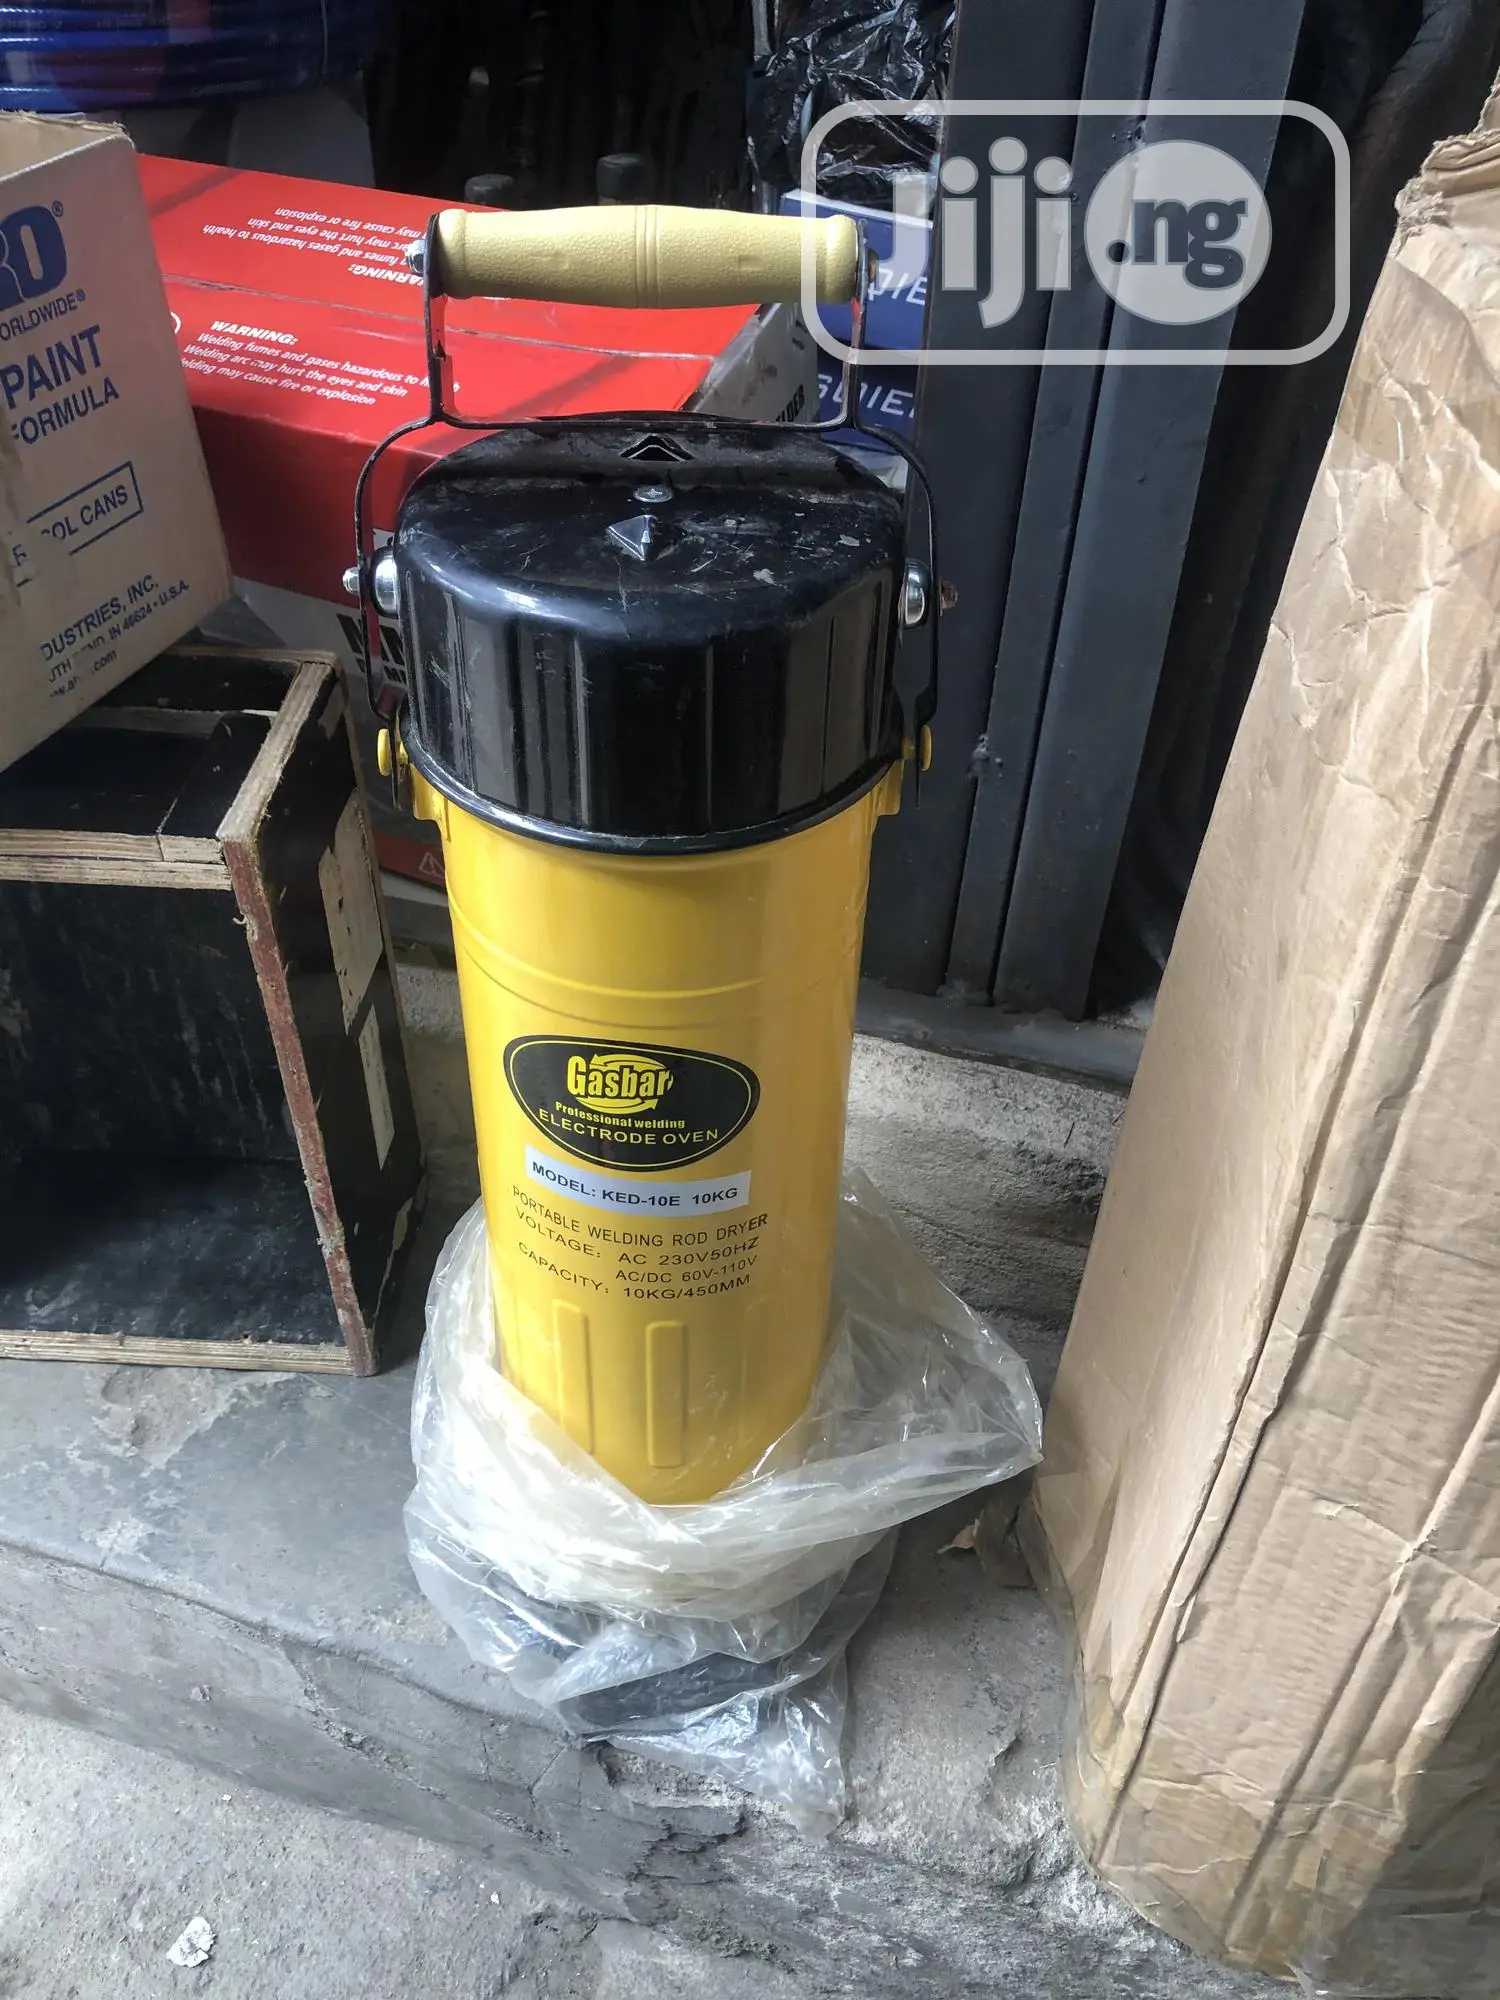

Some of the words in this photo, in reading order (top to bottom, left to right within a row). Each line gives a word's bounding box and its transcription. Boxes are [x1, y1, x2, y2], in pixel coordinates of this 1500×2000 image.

[247, 217, 270, 229] skin
[274, 207, 326, 223] explosion
[326, 215, 342, 225] or
[203, 224, 237, 239] health
[269, 221, 293, 231] and
[293, 224, 318, 236] eyes
[342, 218, 360, 231] fire
[363, 222, 395, 234] cause
[238, 230, 251, 240] to
[251, 232, 307, 250] hazardous
[319, 228, 339, 241] the
[340, 232, 364, 246] hurt
[366, 237, 391, 249] may
[308, 241, 342, 257] gases
[338, 247, 360, 258] and
[363, 251, 399, 266] fumes
[348, 263, 424, 286] ARNING:
[210, 320, 298, 345] WARNING:
[0, 324, 101, 410] PAINT
[197, 333, 244, 351] Welding
[244, 341, 281, 357] fumes
[281, 350, 308, 362] and
[303, 355, 340, 370] gases
[340, 361, 403, 382] hazardous
[404, 374, 419, 385] to
[184, 344, 231, 363] Welding
[230, 354, 251, 365] arc
[250, 359, 278, 372] may
[277, 363, 305, 377] hurt
[305, 369, 327, 381] the
[327, 375, 355, 387] eyes
[355, 380, 383, 393] and
[380, 385, 408, 397] skin
[181, 357, 216, 374] elding
[216, 366, 243, 379] may
[243, 372, 278, 385] cause
[278, 378, 300, 390] fire
[300, 383, 317, 393] or
[316, 387, 376, 405] explosion
[11, 377, 119, 444] ORMULA
[80, 485, 129, 525] CANS
[127, 575, 158, 603] INC.
[567, 1055, 670, 1098] Gasbar
[539, 1108, 656, 1145] ELECTRODE
[662, 1128, 719, 1145] OVEN
[634, 1118, 686, 1129] welding
[532, 1161, 596, 1197] MODEL:
[602, 1189, 681, 1207] KED-10E
[692, 1187, 738, 1205] 10KG
[512, 1185, 580, 1233] PORTABLE
[587, 1224, 663, 1246] WELDING
[672, 1231, 708, 1246] ROD
[716, 1213, 768, 1241] DRYER
[516, 1206, 601, 1258] VOLTAGE:
[618, 1253, 647, 1265] AC
[658, 1235, 759, 1266] 230V50HZ
[518, 1241, 609, 1294] CAPACITY:
[623, 1274, 750, 1300] 10KG/450MM
[616, 1270, 672, 1284] AC/DC
[682, 1255, 758, 1282] 60V-110V
